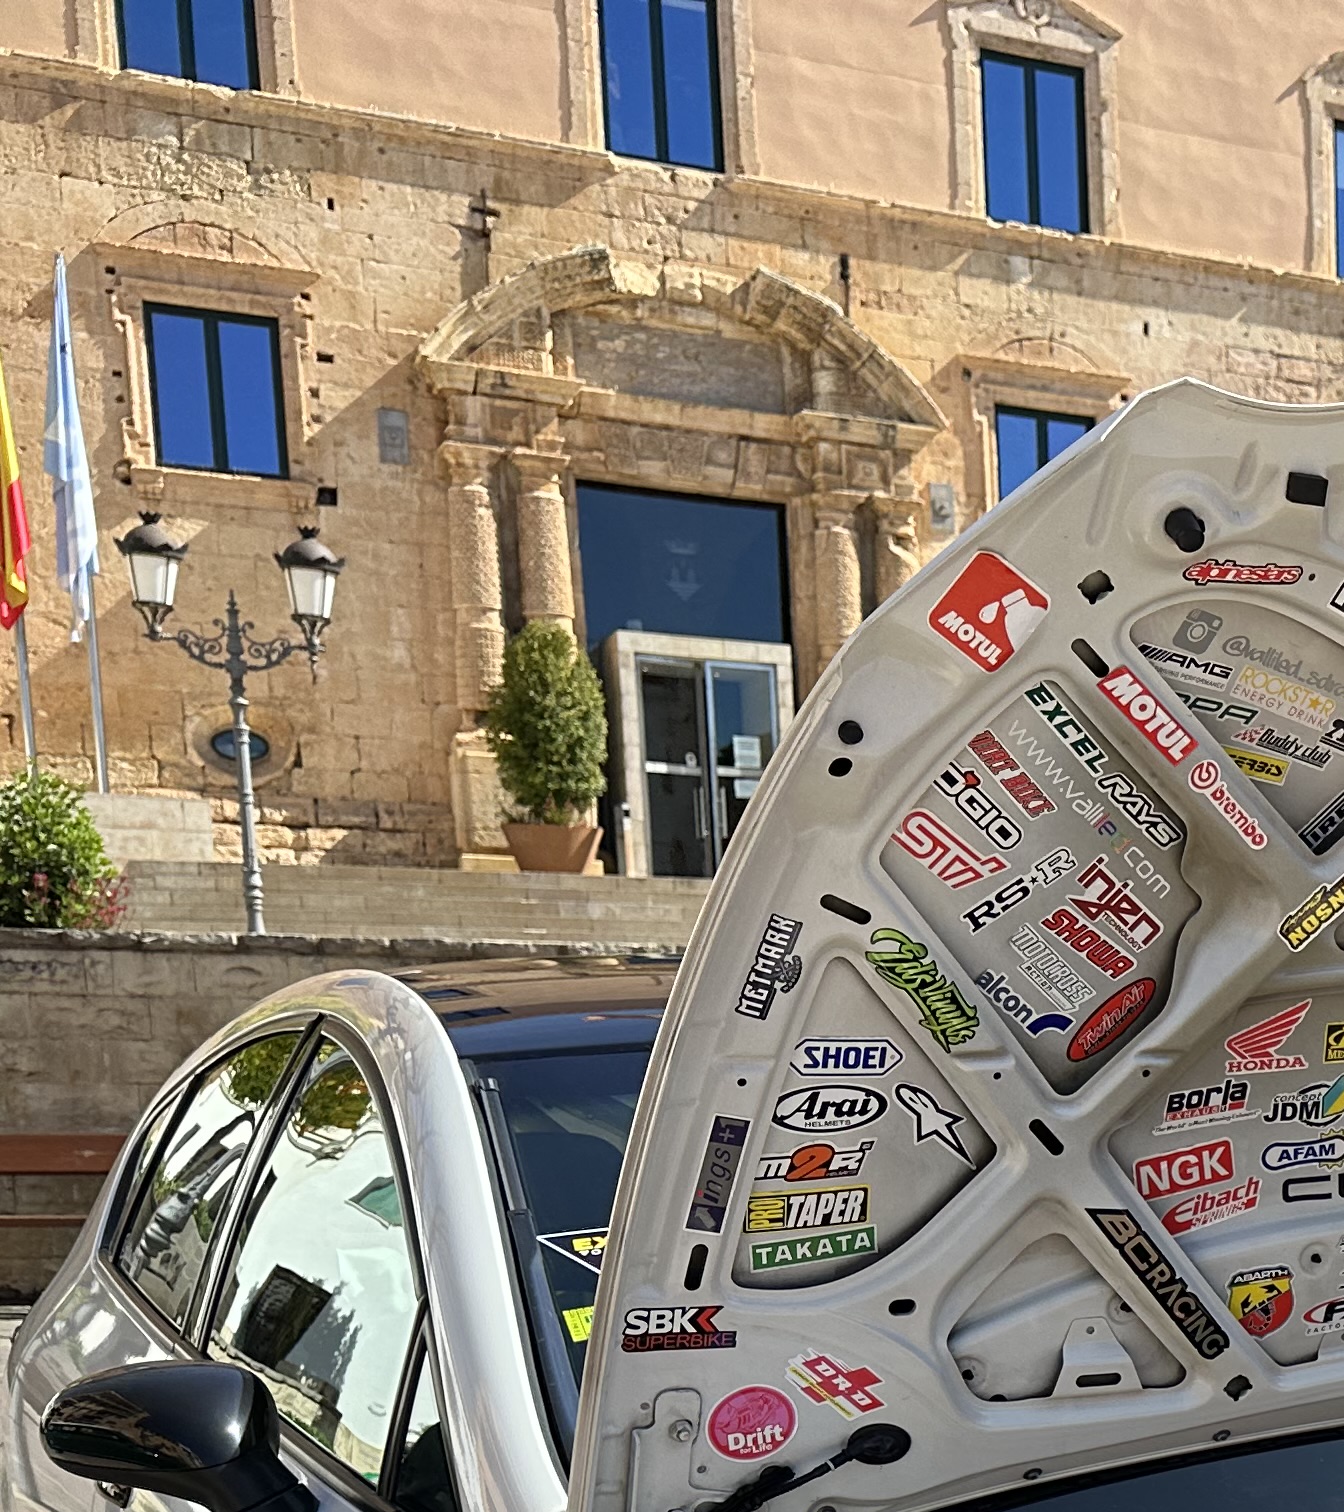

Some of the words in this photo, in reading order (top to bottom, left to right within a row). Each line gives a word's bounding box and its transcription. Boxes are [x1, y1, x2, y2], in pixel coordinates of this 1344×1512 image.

[1186, 561, 1301, 584] alpinestars
[939, 611, 1002, 666] MOTUL
[1164, 655, 1232, 679] AMG
[1103, 673, 1196, 760] MOTUL
[1233, 684, 1284, 711] ENERGY
[1286, 704, 1327, 729] DRINK
[1024, 681, 1108, 775] EXCEL
[1260, 728, 1301, 759] Buddy
[1211, 778, 1265, 848] brembo
[1040, 909, 1134, 979] SHOWA
[1101, 911, 1144, 951] TECHNOLOGY
[739, 915, 797, 1017] METMARK
[976, 970, 1033, 1024] alcon
[804, 1047, 887, 1069] SHOEI
[1228, 1057, 1306, 1073] HONDA
[789, 1092, 873, 1120] Arai
[1263, 1102, 1321, 1122] JDM
[1273, 1092, 1322, 1103] concept
[804, 1120, 851, 1128] HELMETS
[1166, 1104, 1227, 1121] EXHAUST
[1277, 1143, 1336, 1162] AFAM
[1140, 1147, 1230, 1194] NGK
[748, 1199, 785, 1229] PRO
[787, 1188, 862, 1228] TAPER
[755, 1231, 872, 1265] TAKATA
[1234, 1269, 1288, 1284] ABARTH
[625, 1308, 699, 1335] SBK
[622, 1332, 734, 1351] SUPERBIKE
[728, 1424, 785, 1453] Drift
